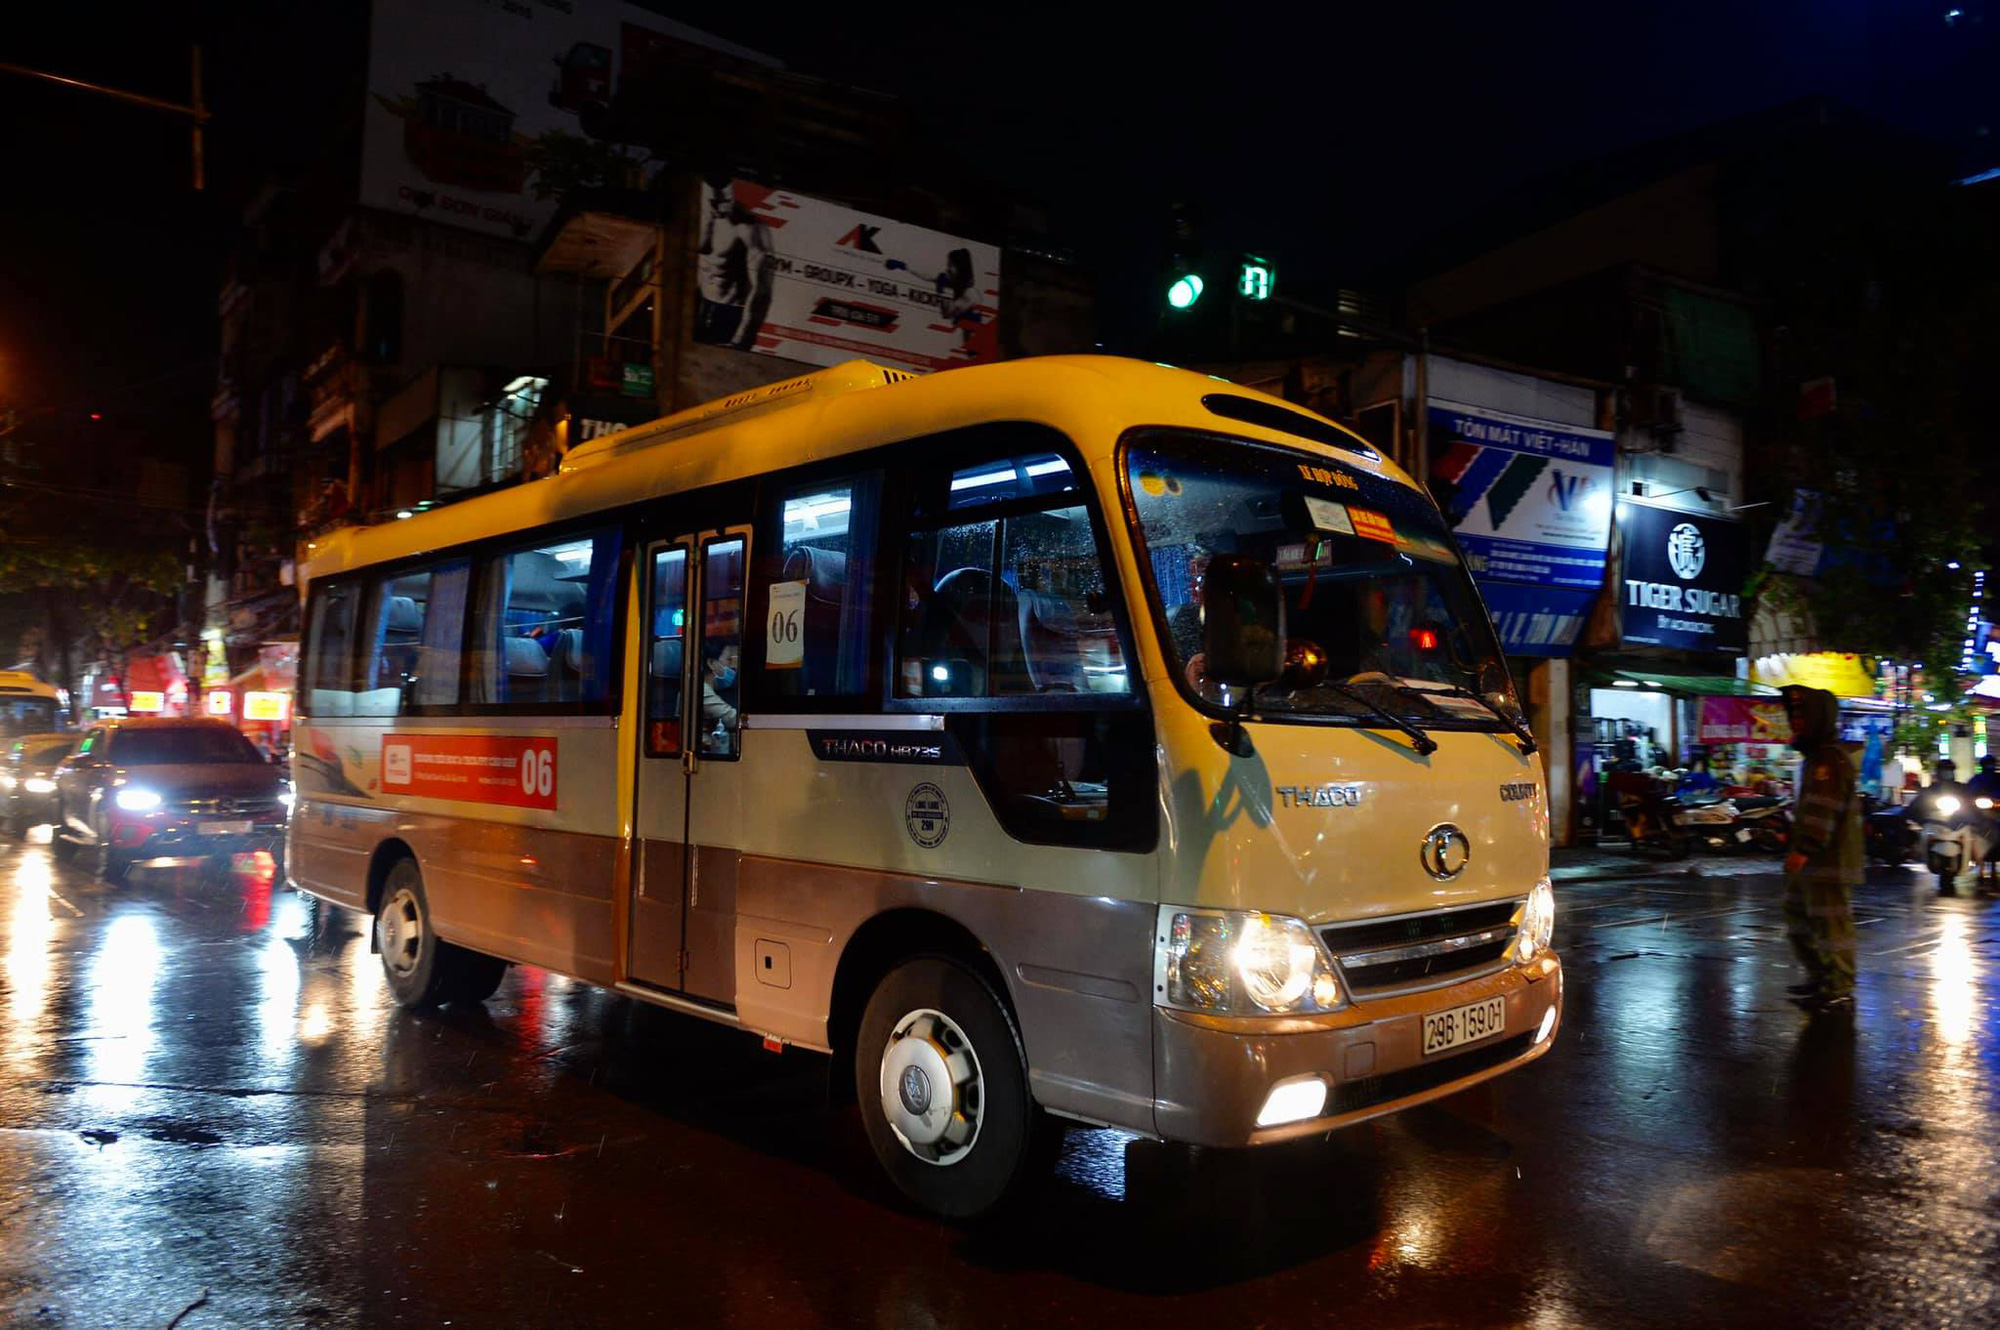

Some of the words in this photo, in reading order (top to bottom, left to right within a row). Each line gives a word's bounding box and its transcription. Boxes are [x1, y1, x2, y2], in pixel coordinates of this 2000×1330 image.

[804, 264, 855, 288] GROUPX
[867, 277, 899, 299] YOGA
[1453, 417, 1486, 440] TÔN
[1487, 424, 1521, 446] MÁT
[1624, 579, 1683, 611] TIGER
[1684, 588, 1741, 618] SUGAR
[772, 608, 799, 644] 06
[822, 738, 887, 756] THACO
[521, 749, 553, 797] 06
[1276, 785, 1362, 808] THACO
